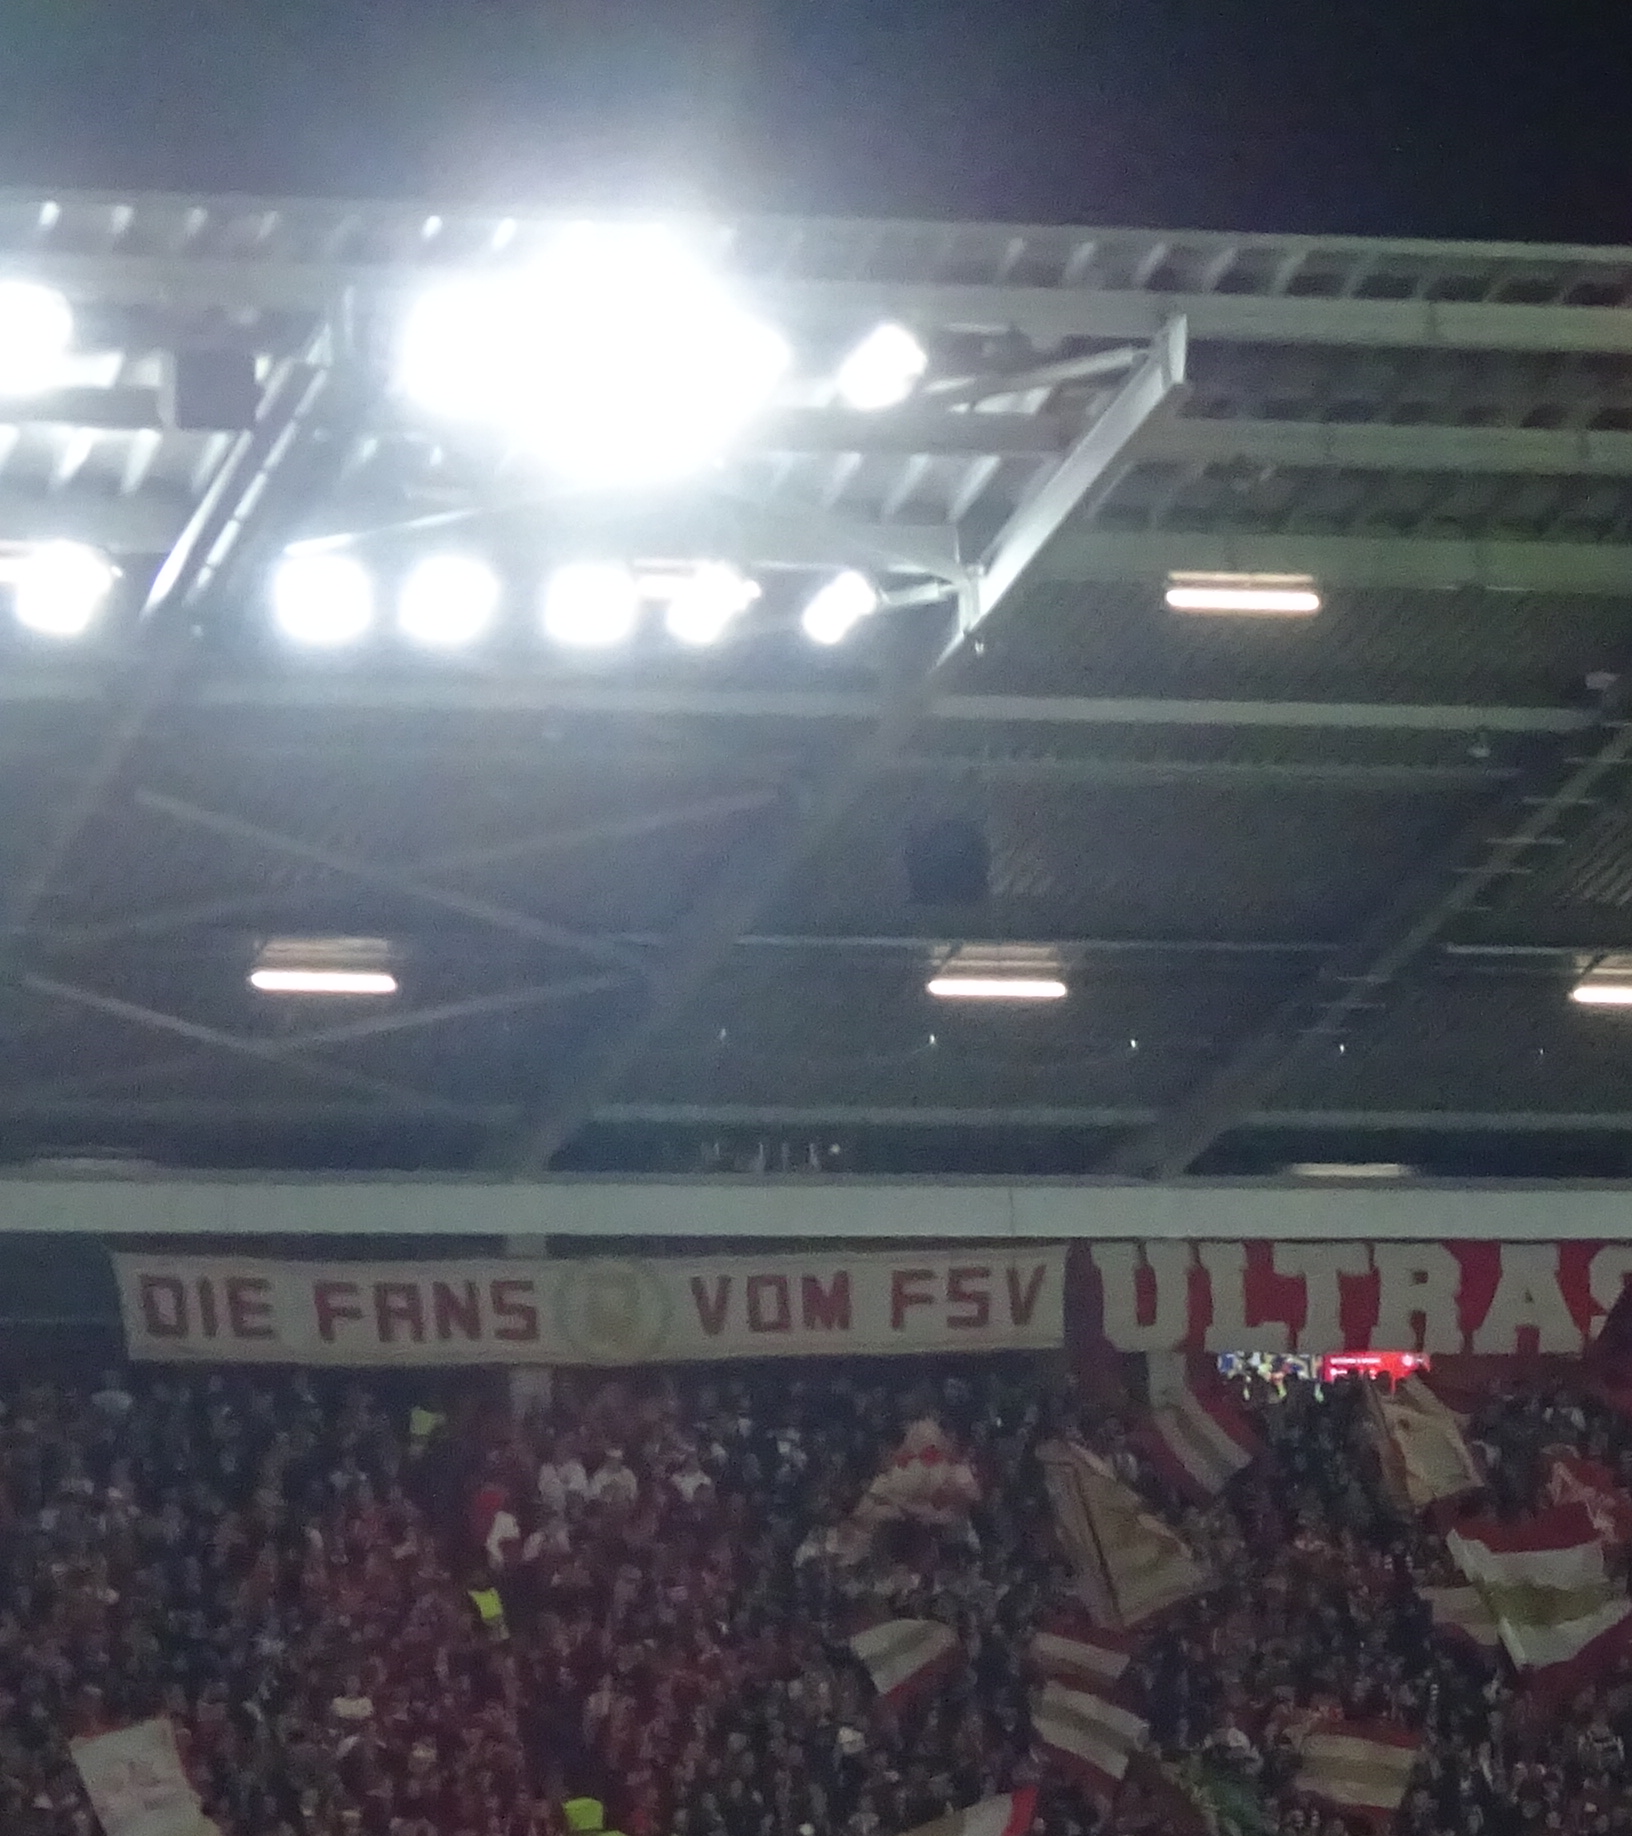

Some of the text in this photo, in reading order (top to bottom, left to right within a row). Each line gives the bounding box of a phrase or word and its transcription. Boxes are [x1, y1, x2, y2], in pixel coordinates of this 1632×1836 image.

[138, 1266, 1047, 1341] DIE FANS VOM FSV
